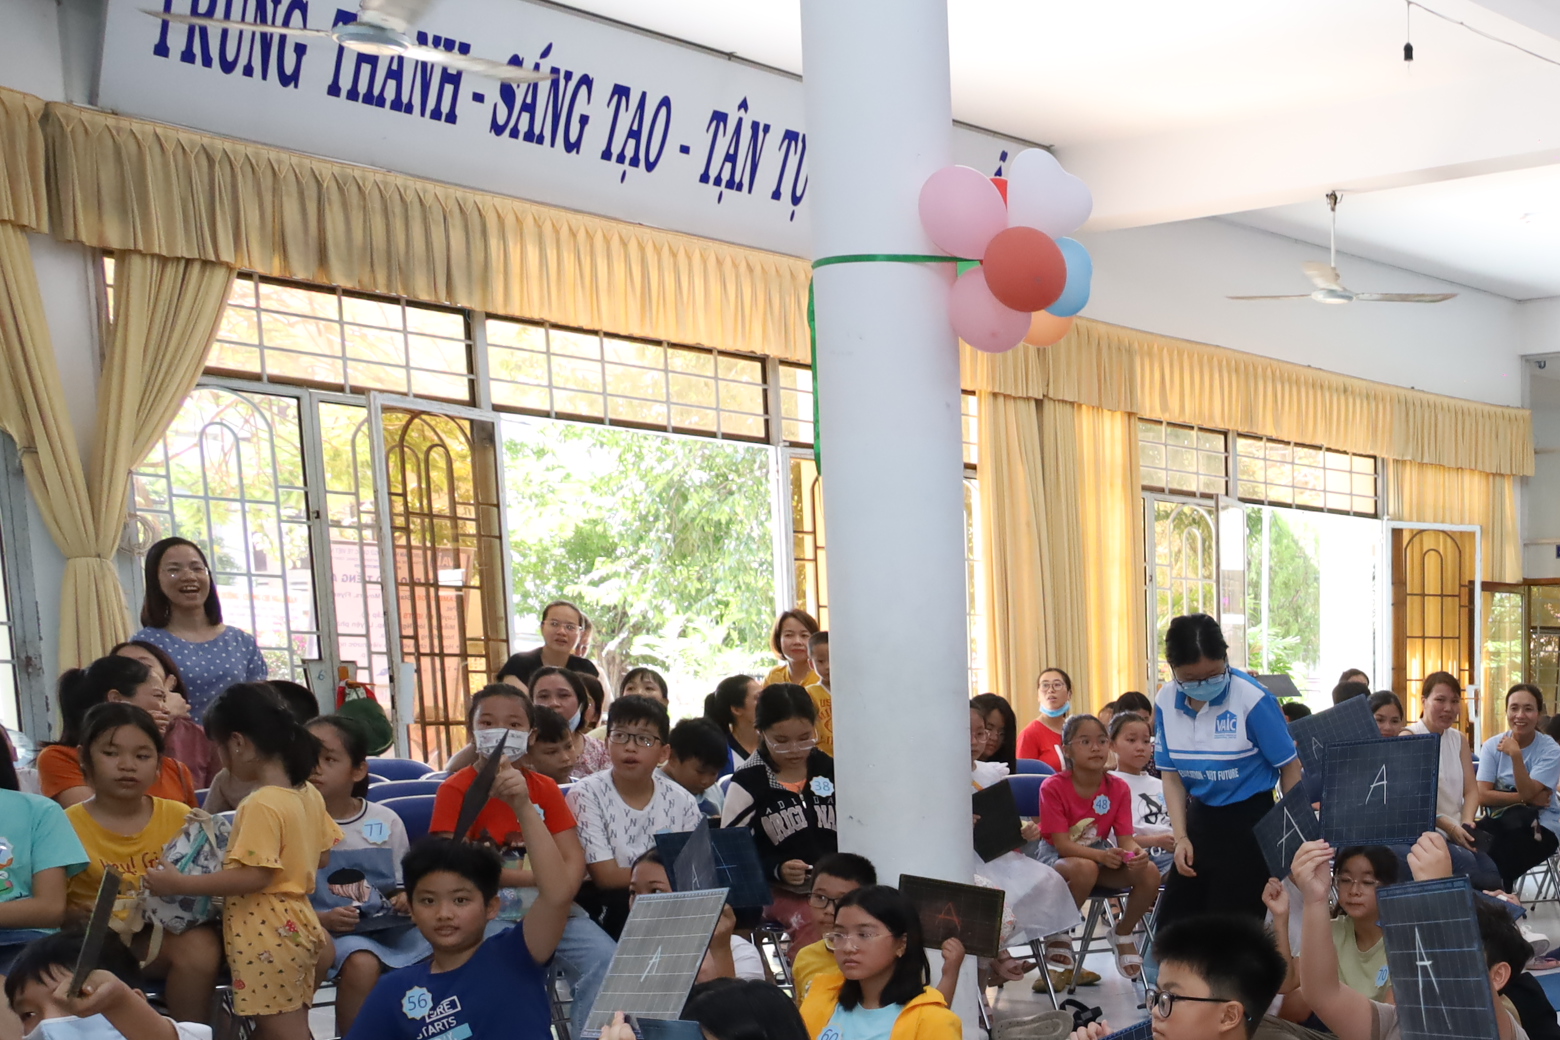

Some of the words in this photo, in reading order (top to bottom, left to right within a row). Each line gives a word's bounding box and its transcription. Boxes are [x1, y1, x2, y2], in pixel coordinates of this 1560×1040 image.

[489, 42, 594, 155] SÁNG
[601, 83, 672, 184] TẠO
[699, 96, 771, 204] TẬN
[814, 780, 831, 792] 38
[1217, 767, 1239, 780] FUTURE
[1365, 763, 1388, 805] A
[1096, 799, 1108, 810] 48
[364, 822, 382, 837] 77
[1276, 806, 1307, 869] A
[935, 901, 961, 932] A
[640, 945, 661, 983] A
[1415, 925, 1452, 1032] A
[407, 992, 428, 1011] 56
